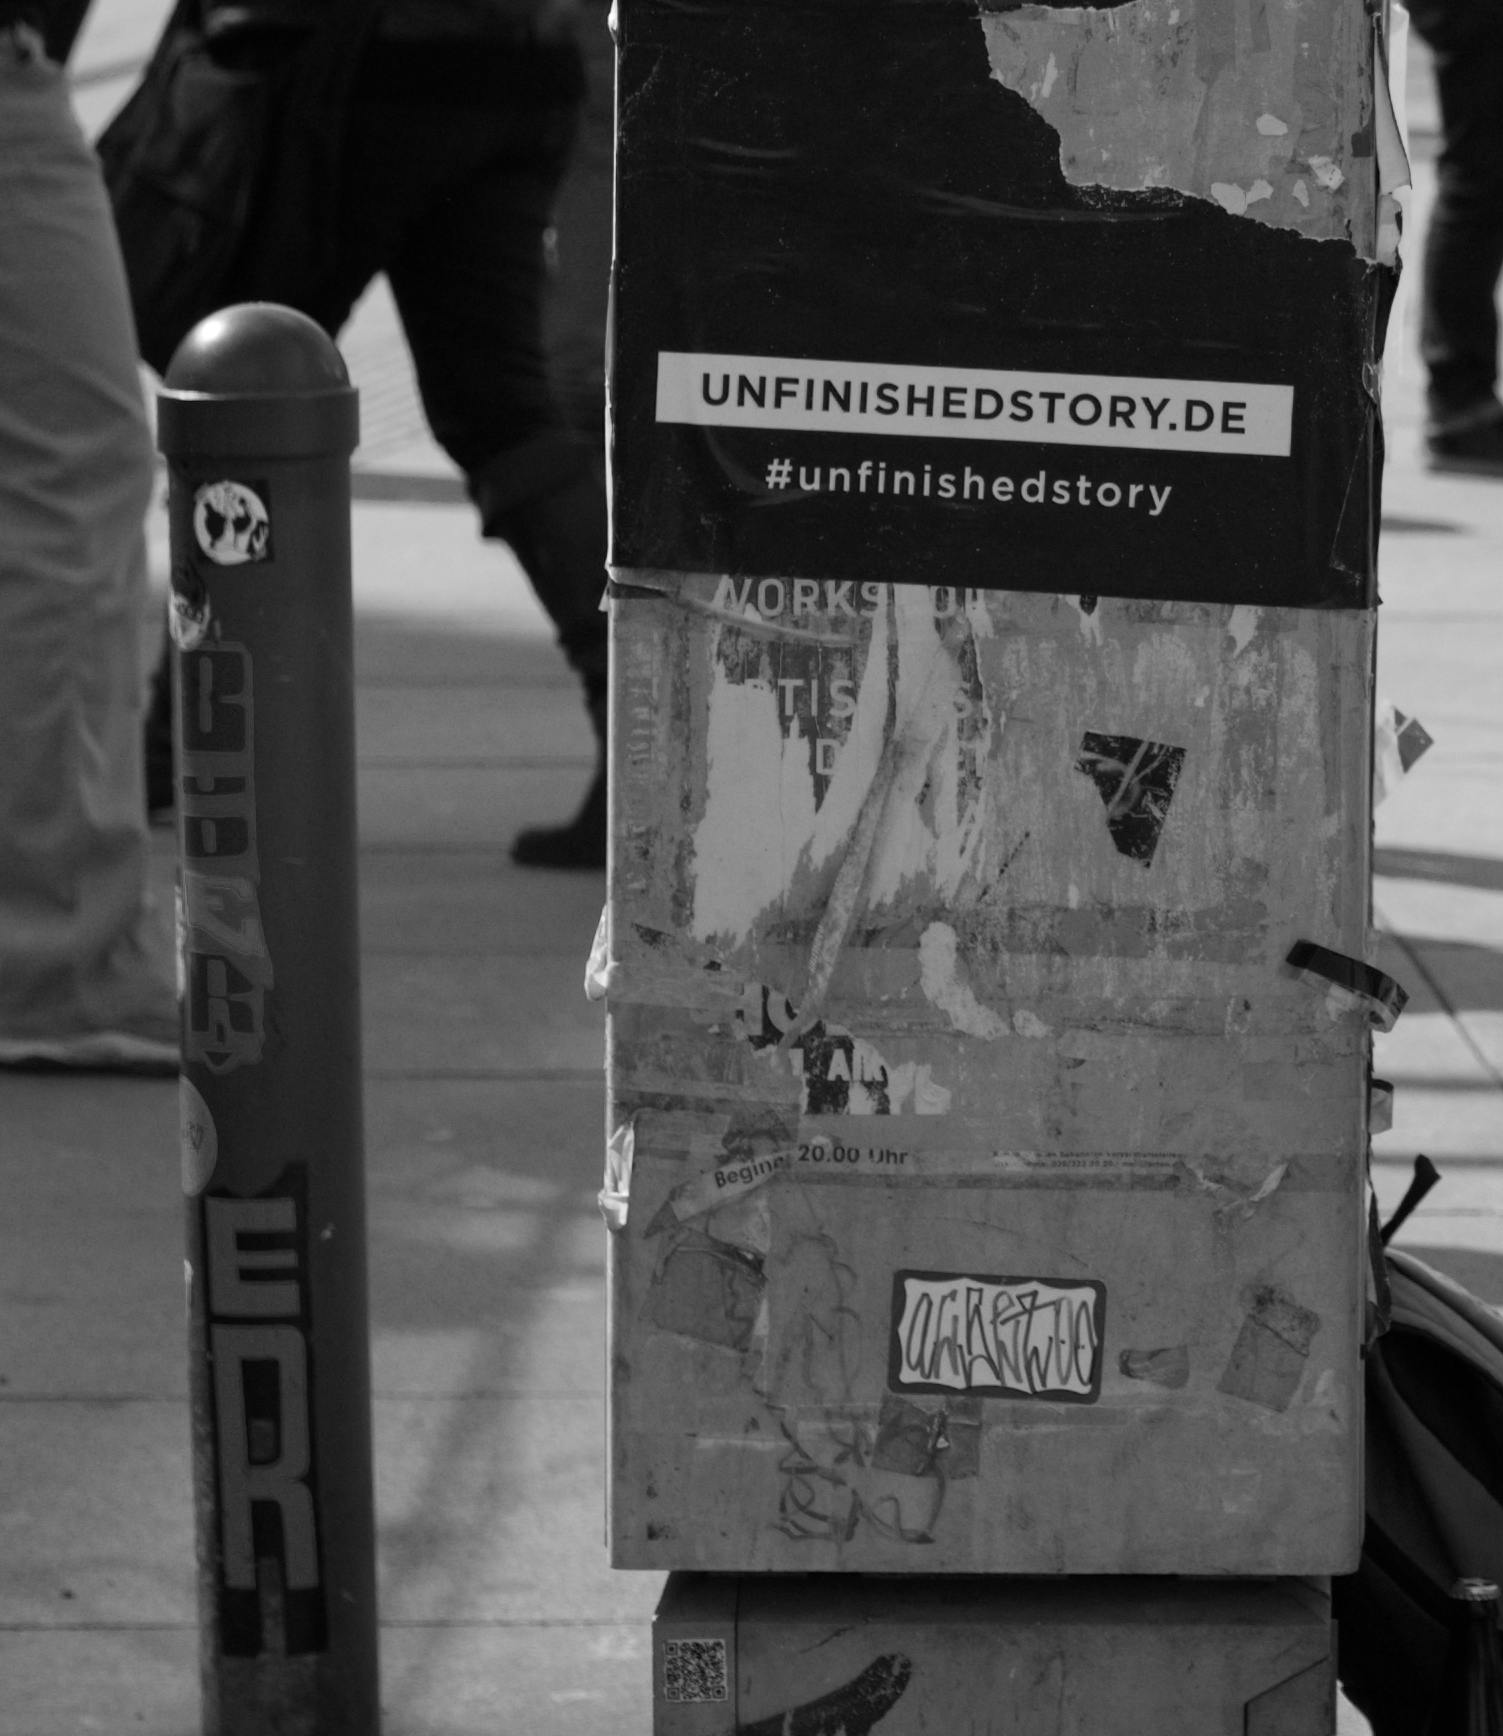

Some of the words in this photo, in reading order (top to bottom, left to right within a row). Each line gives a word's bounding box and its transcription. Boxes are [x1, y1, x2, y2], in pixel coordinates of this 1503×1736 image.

[701, 372, 1249, 436] UNFINISHEDSTORY.DE
[765, 457, 1174, 517] #unfinishedstory
[797, 1144, 861, 1164] 20.00
